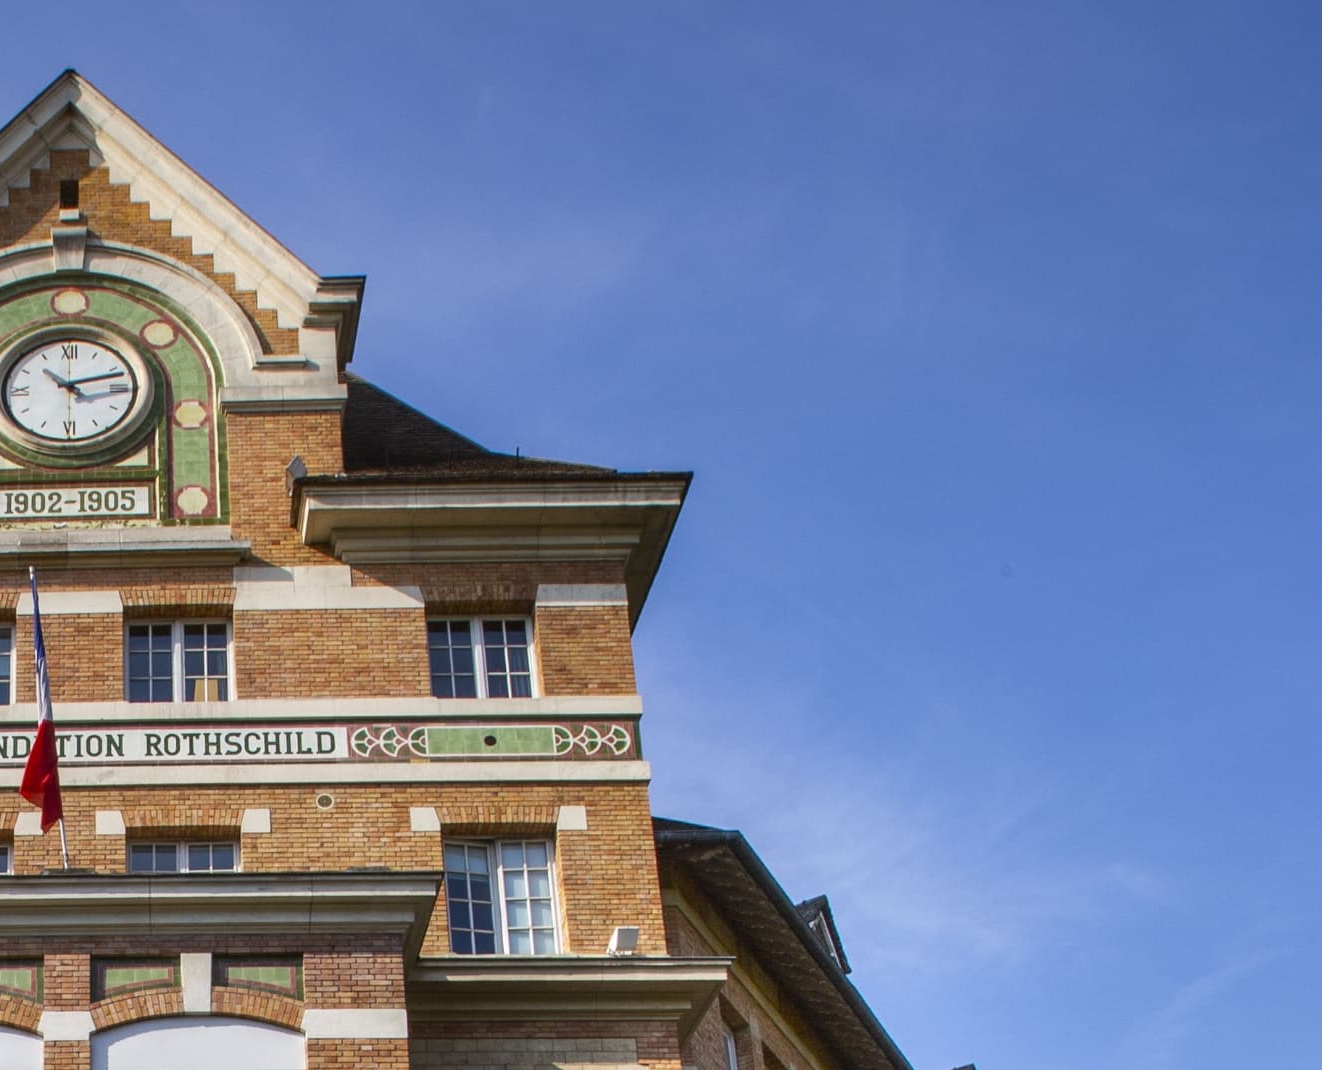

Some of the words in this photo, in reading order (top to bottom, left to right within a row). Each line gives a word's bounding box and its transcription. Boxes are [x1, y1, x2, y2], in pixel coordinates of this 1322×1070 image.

[61, 344, 78, 361] XII
[63, 421, 76, 435] VI
[4, 489, 136, 515] 1902-1905
[145, 730, 336, 758] ROTHSCHILD
